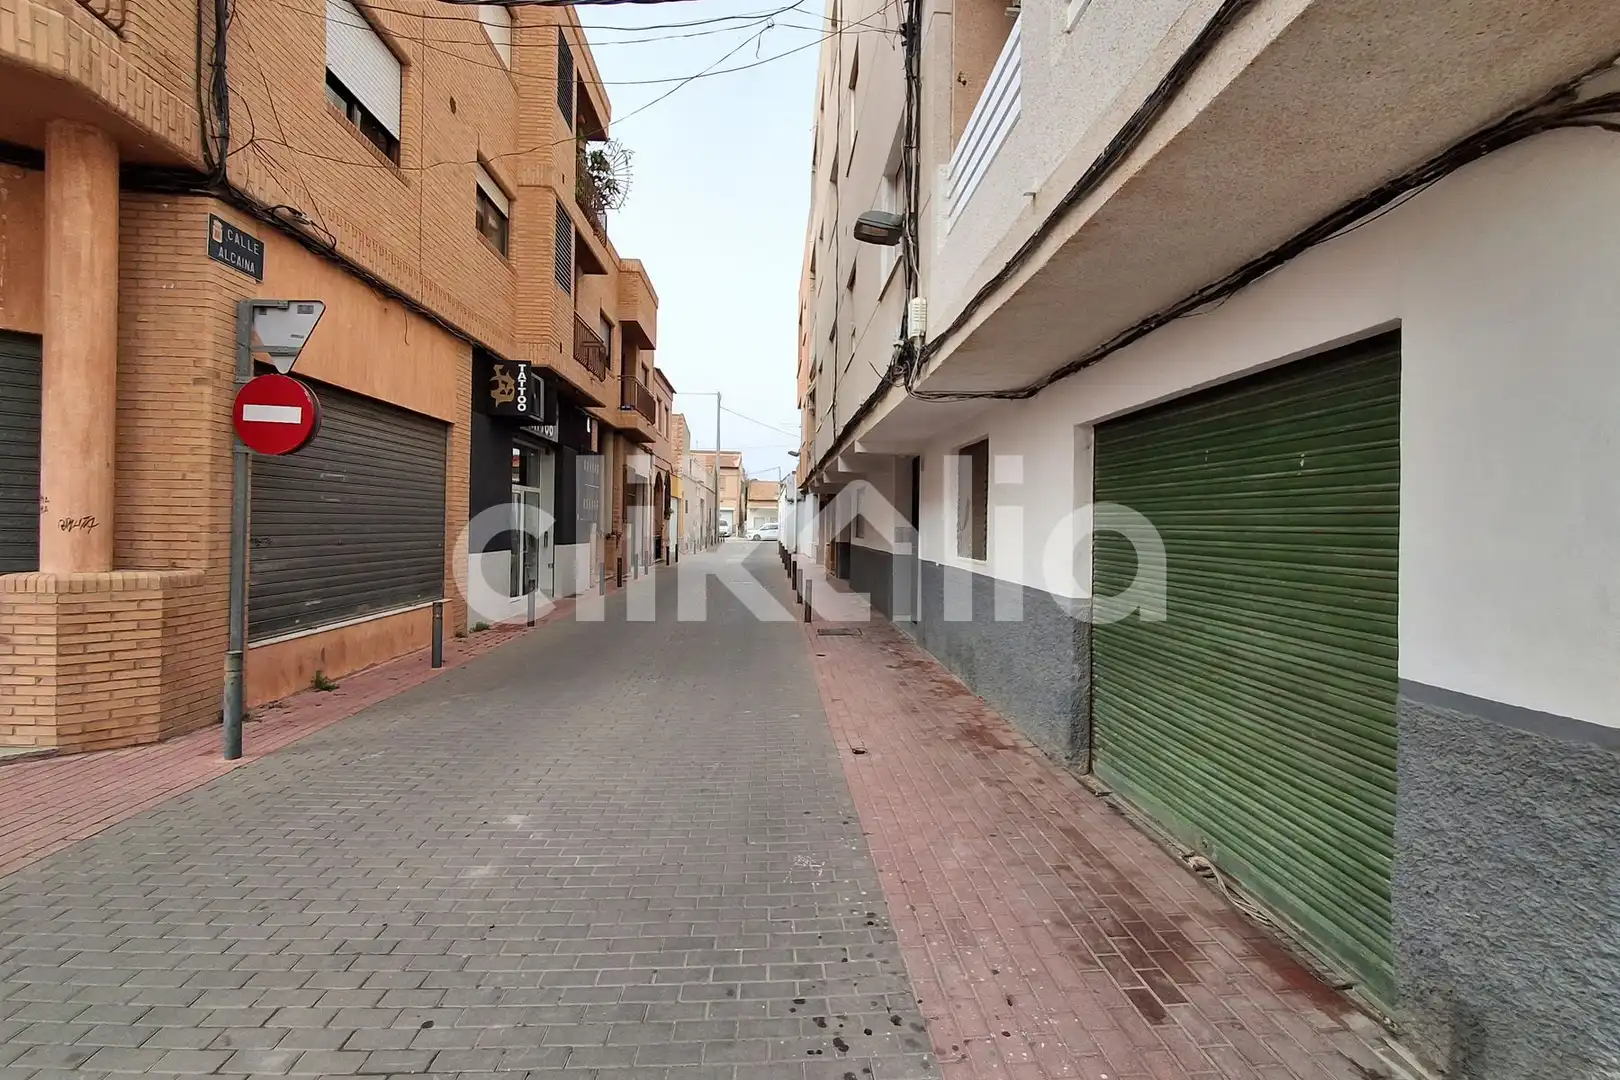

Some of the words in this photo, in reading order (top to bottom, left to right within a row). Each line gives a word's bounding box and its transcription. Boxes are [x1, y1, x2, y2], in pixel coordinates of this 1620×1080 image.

[227, 229, 260, 256] CALLE
[218, 246, 256, 274] ALCAINA
[517, 363, 527, 412] TATTOO
